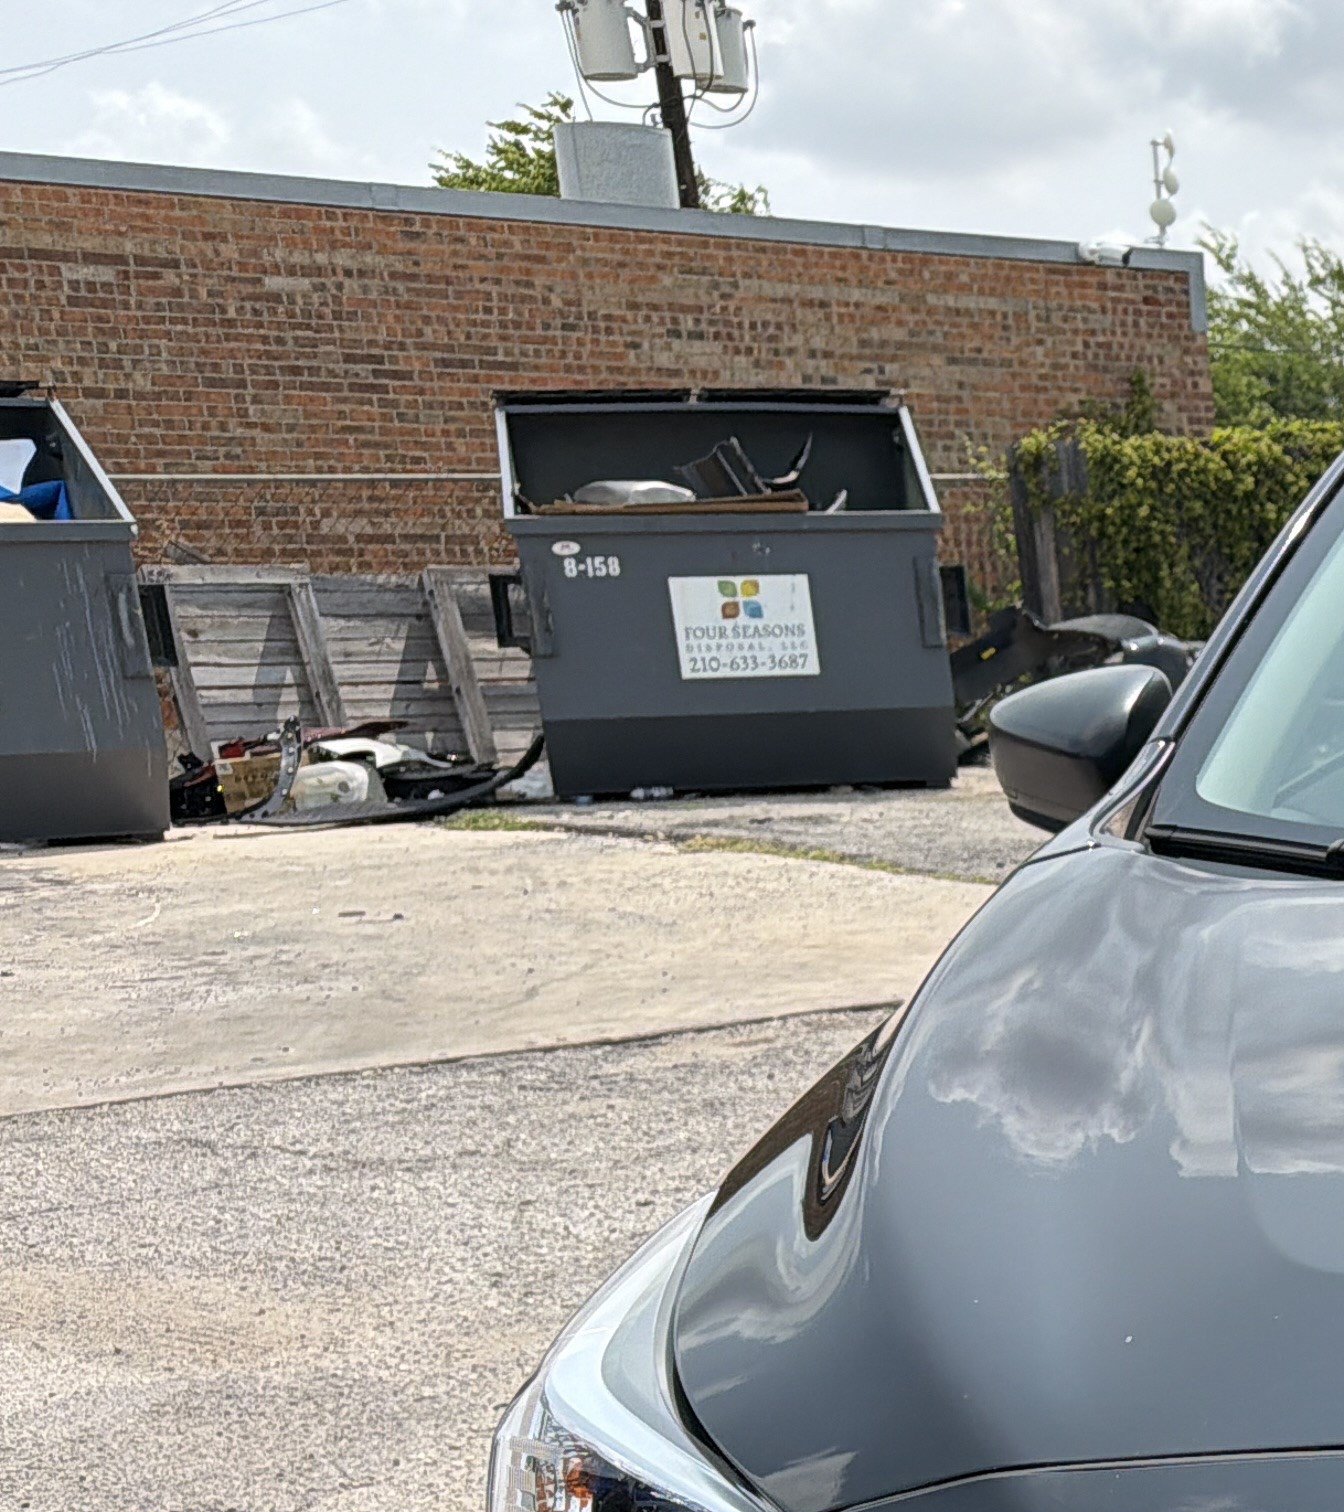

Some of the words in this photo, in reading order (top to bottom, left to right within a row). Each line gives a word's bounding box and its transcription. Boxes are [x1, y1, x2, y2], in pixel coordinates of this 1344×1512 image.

[685, 625, 727, 641] FOUR
[731, 623, 806, 640] SEASONS
[689, 653, 809, 673] 210-633-3687
